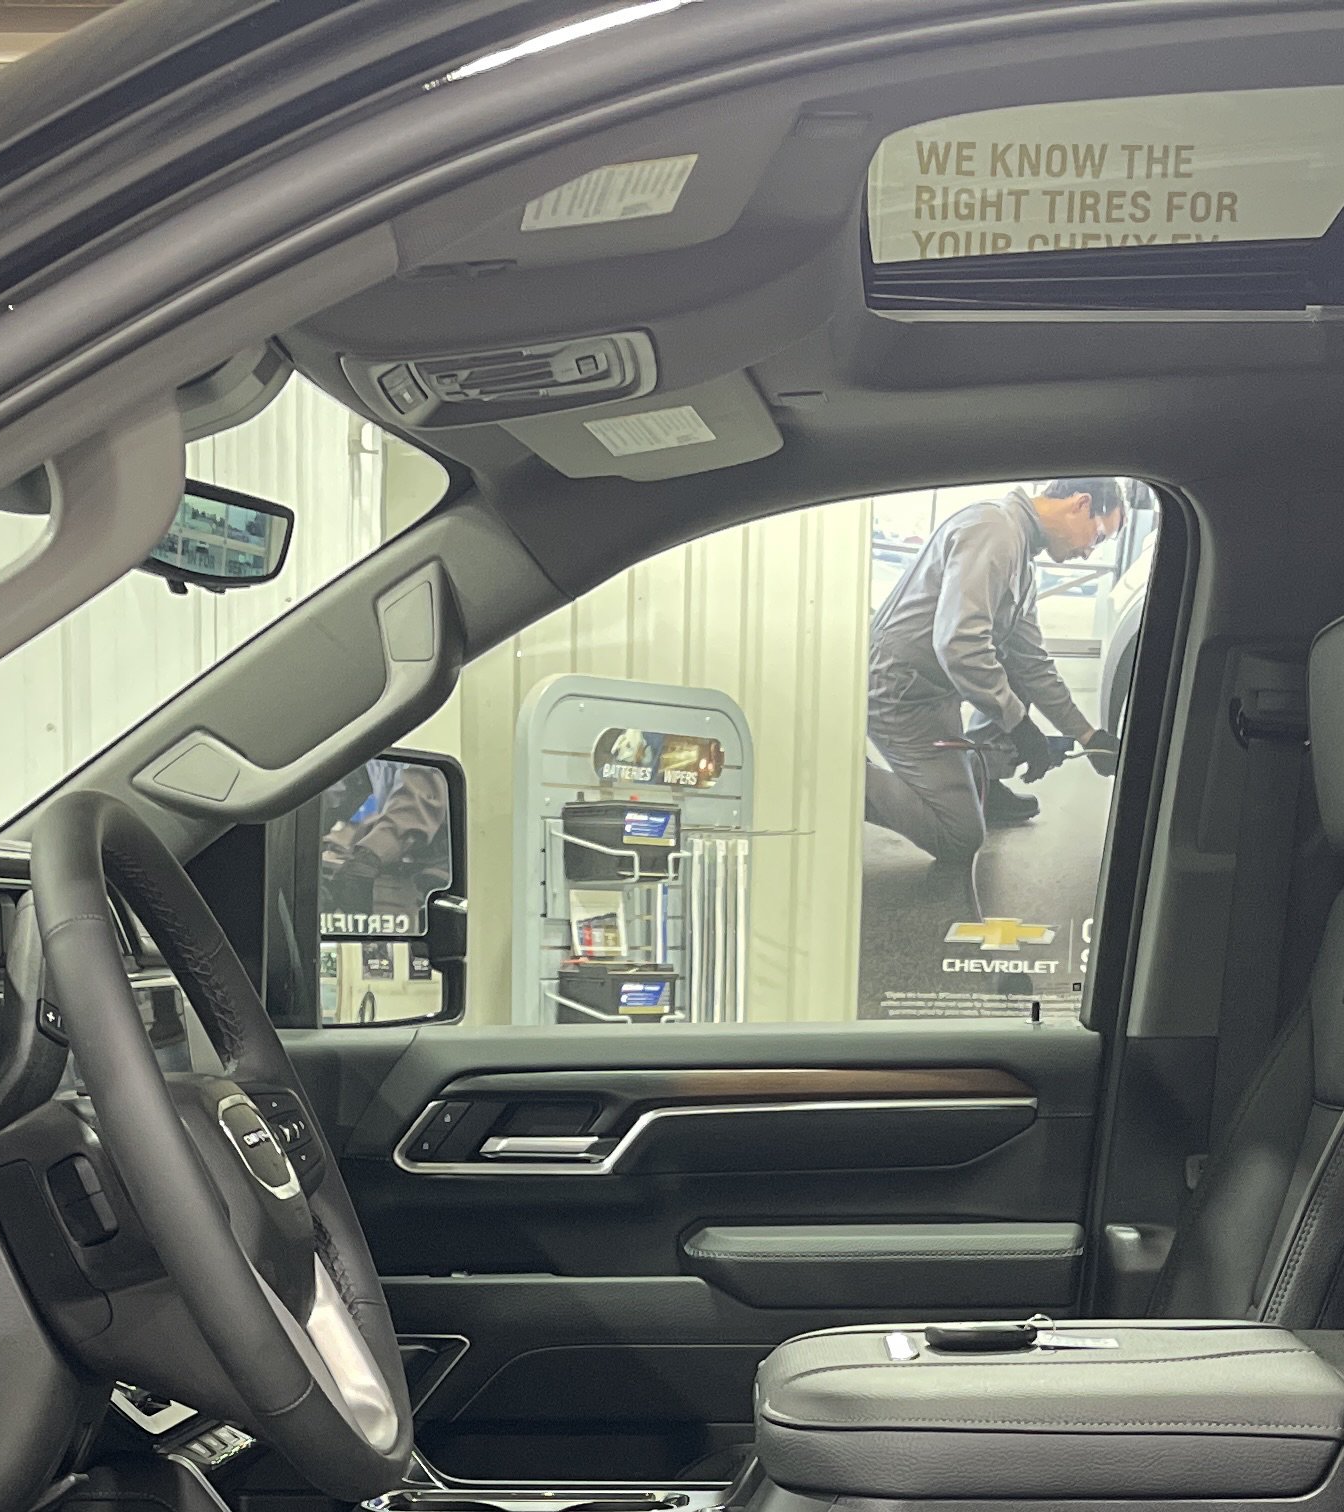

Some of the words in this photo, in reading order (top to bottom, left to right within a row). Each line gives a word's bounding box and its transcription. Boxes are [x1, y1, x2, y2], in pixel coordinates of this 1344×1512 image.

[916, 140, 976, 176] WE
[990, 143, 1108, 179] KNOW
[1121, 144, 1195, 179] THE
[915, 185, 1030, 223] RIGHT
[1041, 190, 1151, 224] TIRES
[1166, 191, 1238, 223] FOR
[663, 768, 698, 786] WIPERS
[942, 959, 1058, 974] CHEVROLET
